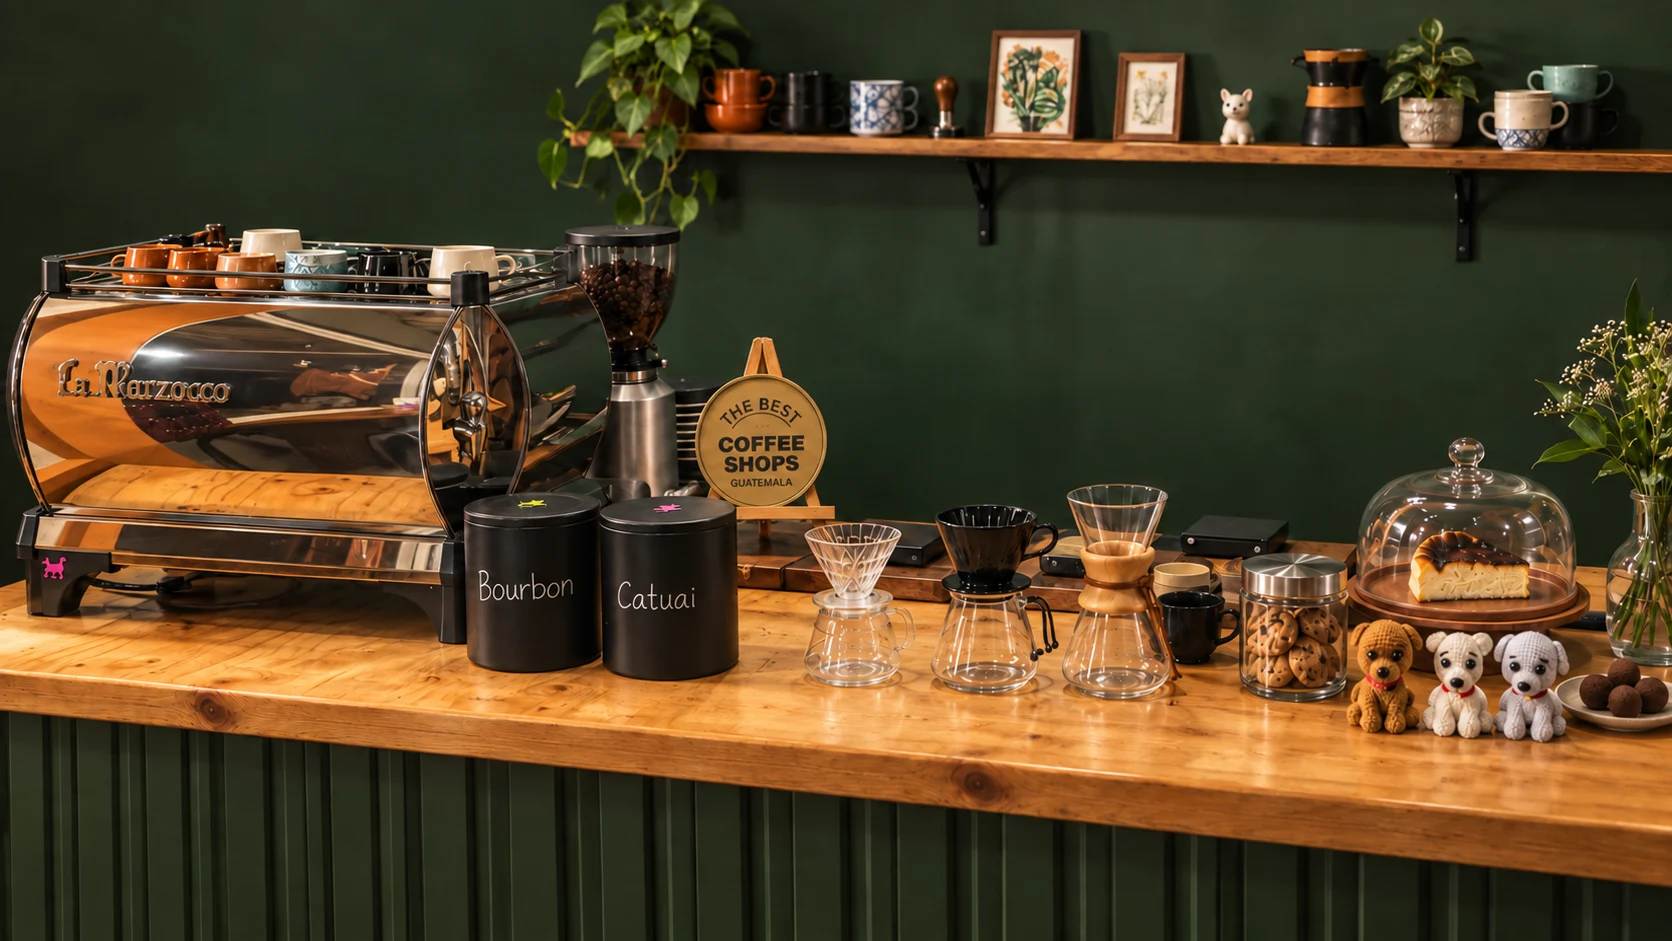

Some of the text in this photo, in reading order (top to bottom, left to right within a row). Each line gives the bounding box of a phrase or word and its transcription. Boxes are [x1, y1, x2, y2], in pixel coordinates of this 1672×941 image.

[57, 358, 232, 404] La Marzocco
[719, 397, 803, 425] THE BEST
[718, 435, 805, 453] COFFEE
[724, 455, 800, 473] SHOPS
[730, 478, 793, 488] GUATEMALA
[478, 569, 574, 602] Bourbon
[617, 581, 696, 611] Catuai
